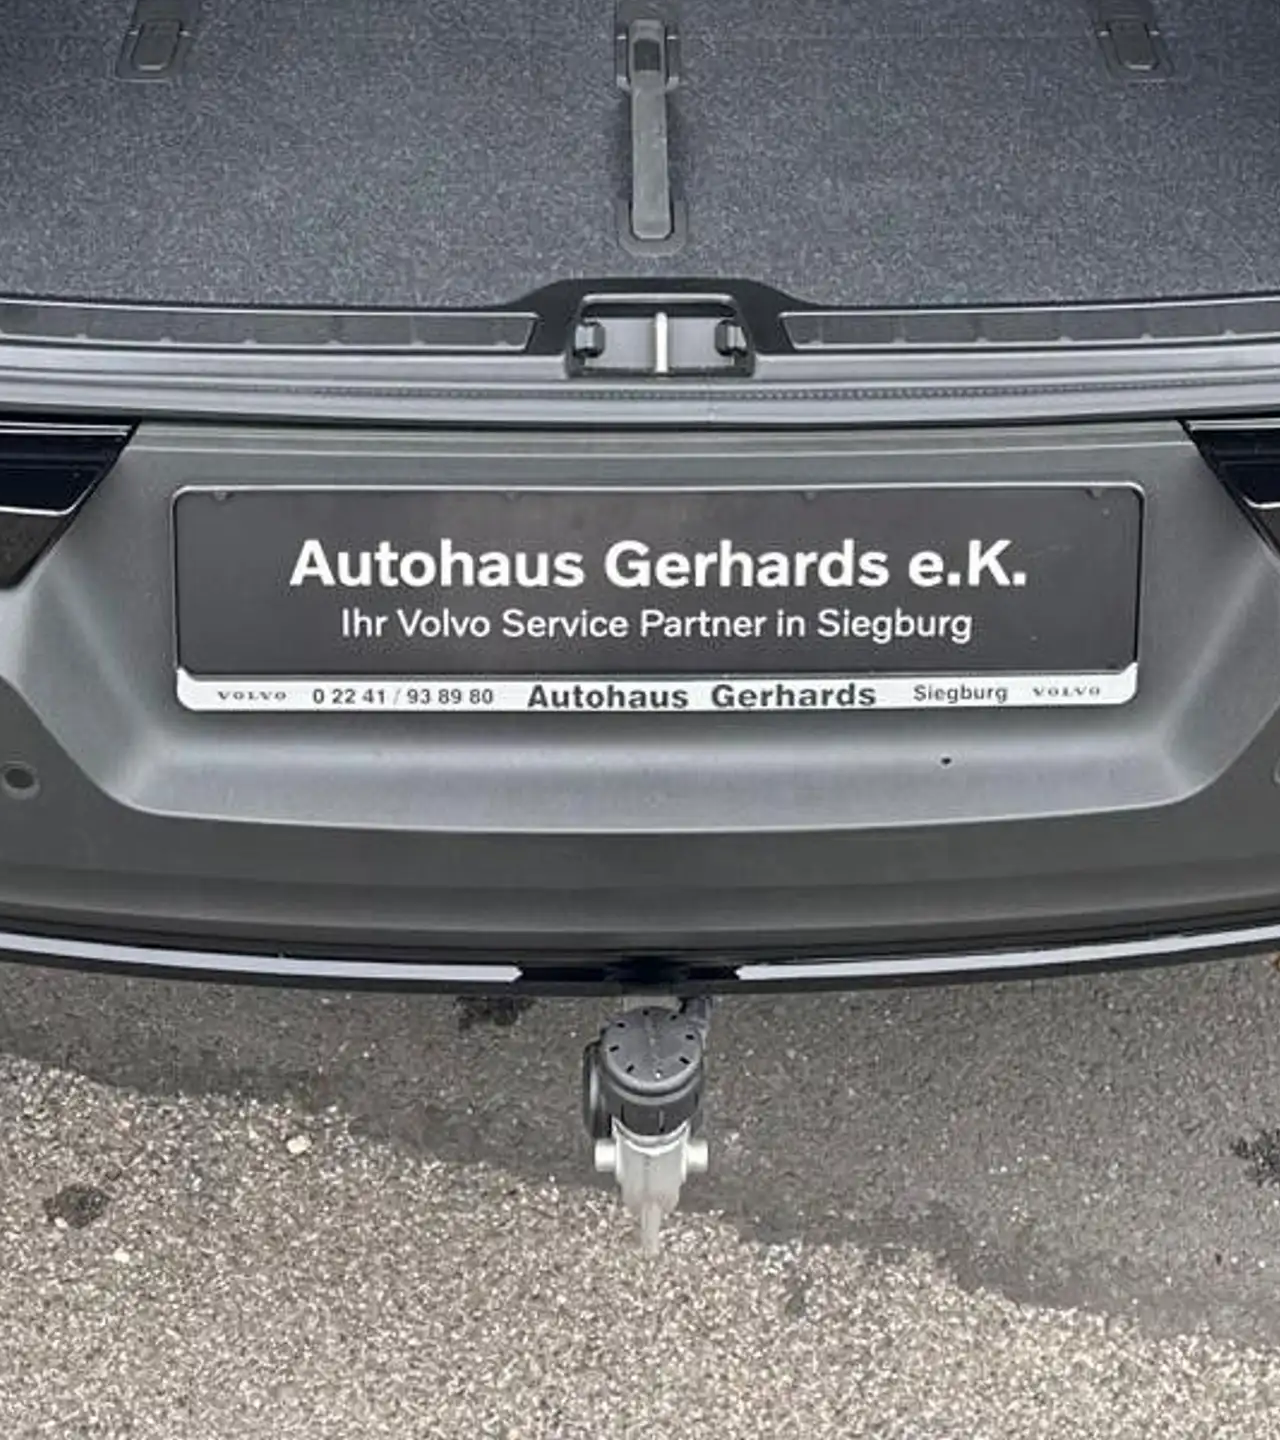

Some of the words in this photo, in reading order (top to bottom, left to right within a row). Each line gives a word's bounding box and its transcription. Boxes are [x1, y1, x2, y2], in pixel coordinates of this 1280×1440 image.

[289, 538, 586, 588] Autohaus
[604, 538, 890, 588] Gerhards
[908, 539, 1027, 587] e.K.
[341, 608, 388, 638] Ihr
[396, 608, 491, 638] Volvo
[502, 609, 629, 638] Service
[641, 609, 767, 638] Partner
[777, 609, 806, 637] in
[817, 607, 973, 644] Siegburg
[218, 690, 287, 701] VOLVO
[331, 688, 356, 705] 22
[362, 688, 386, 705] 41
[407, 688, 431, 705] 93
[438, 688, 462, 705] 89
[469, 688, 494, 705] 80
[526, 683, 690, 709] Autohaus
[711, 682, 877, 708] Gerhards
[913, 683, 1009, 704] Siegburg
[1032, 686, 1101, 697] VOLVO
